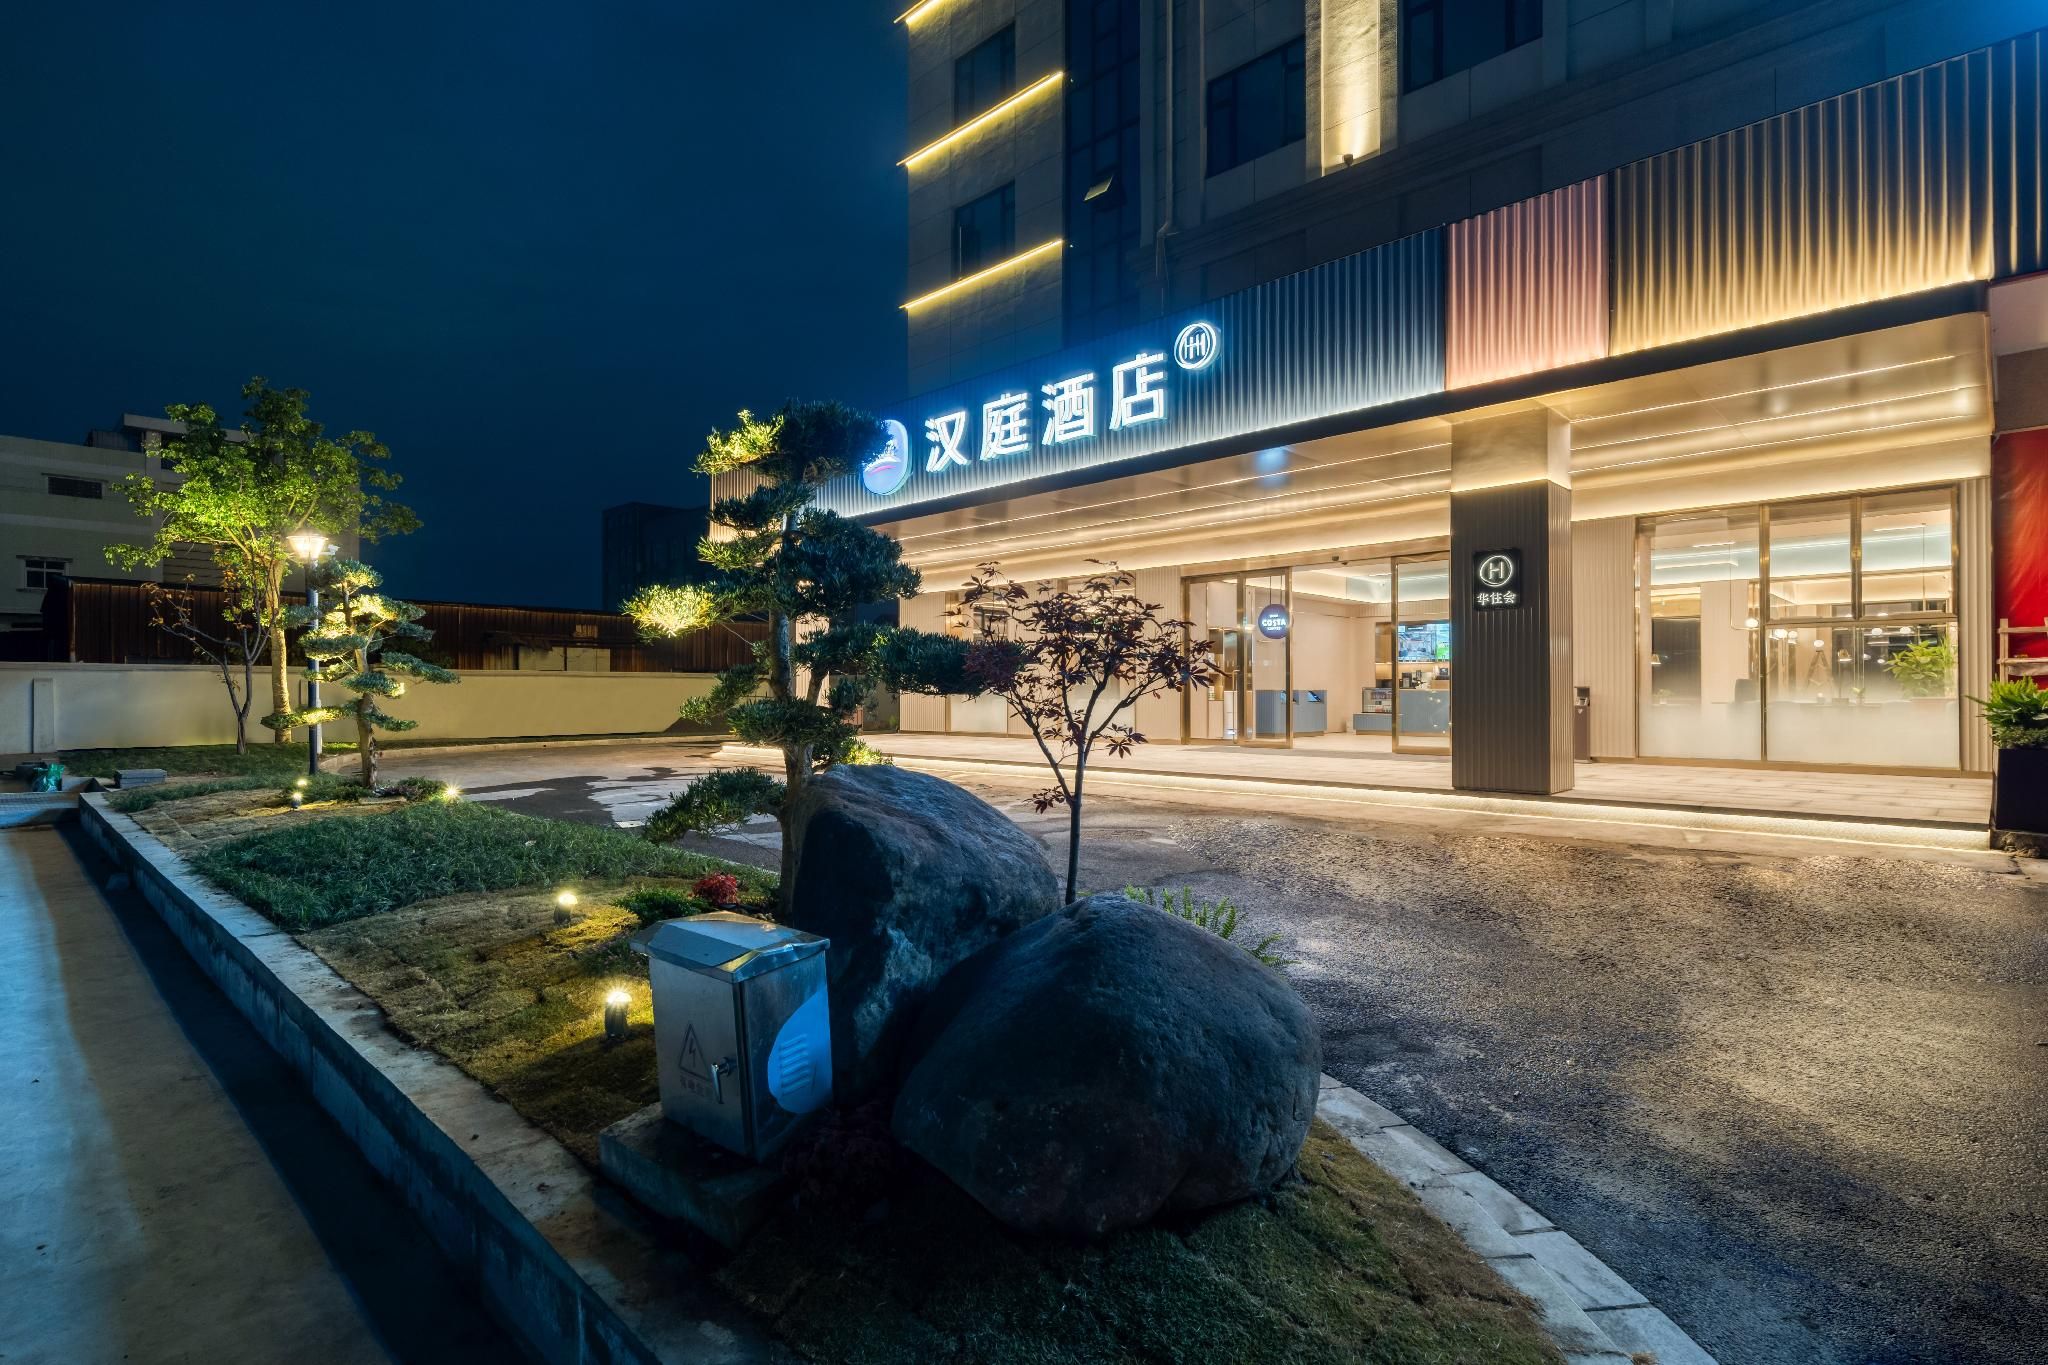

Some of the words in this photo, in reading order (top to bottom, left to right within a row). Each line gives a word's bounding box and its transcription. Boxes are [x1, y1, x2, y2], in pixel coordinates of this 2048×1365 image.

[924, 353, 1167, 472] 汉庭酒店
[1477, 591, 1516, 606] 华住会
[1261, 618, 1287, 627] COSTA
